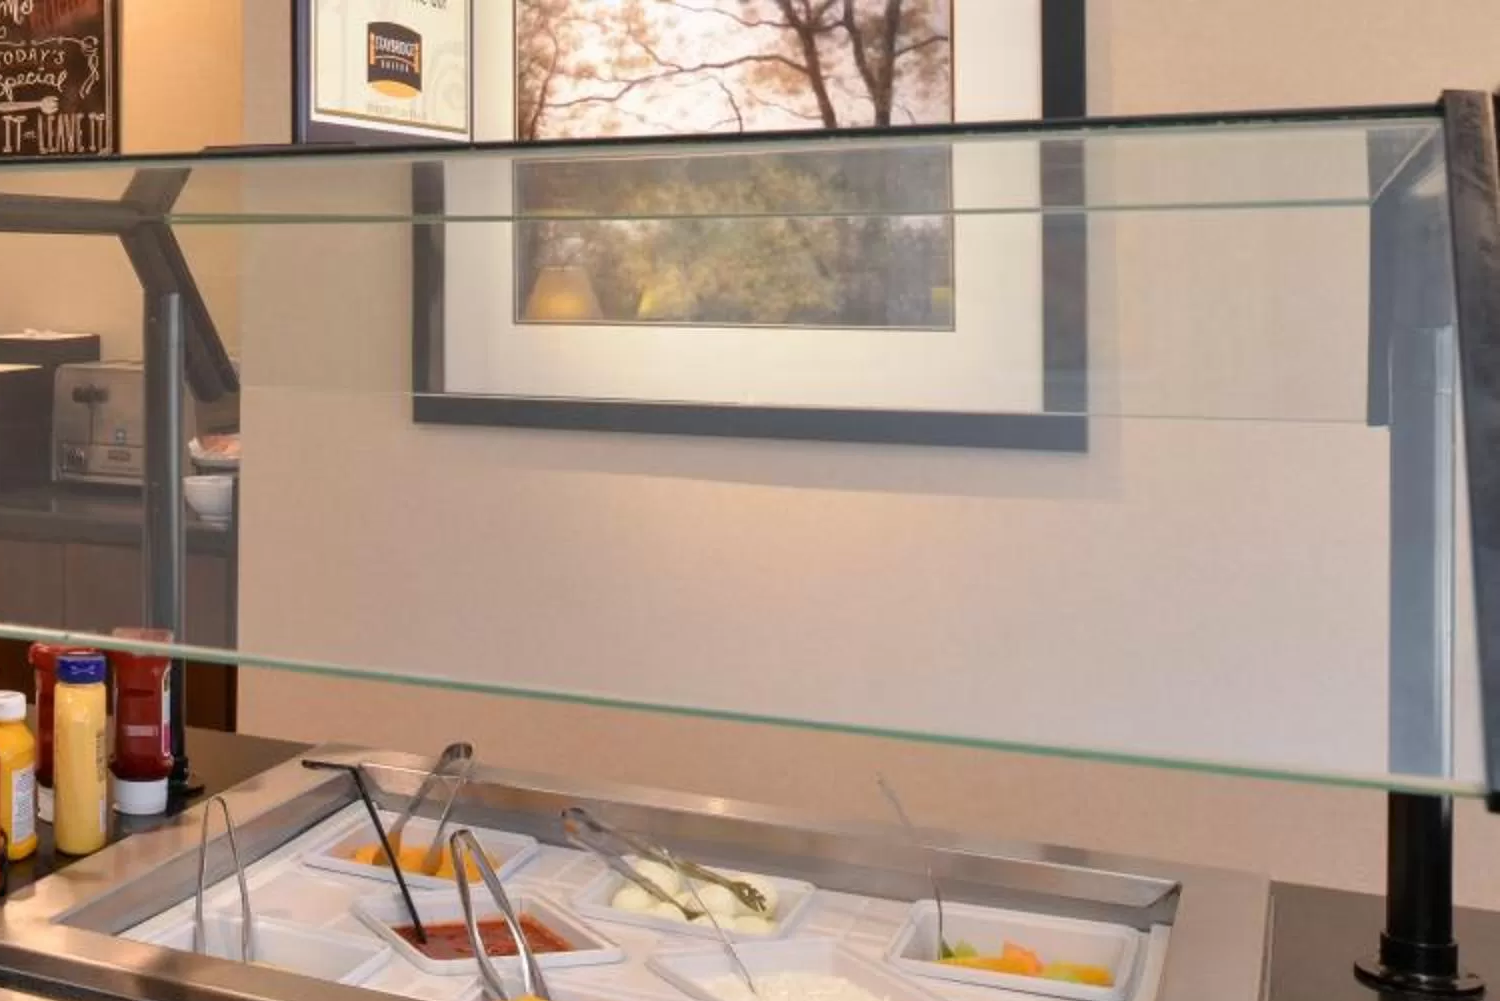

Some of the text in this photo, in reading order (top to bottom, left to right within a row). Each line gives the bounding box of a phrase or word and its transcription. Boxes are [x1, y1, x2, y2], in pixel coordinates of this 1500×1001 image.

[2, 115, 28, 153] IT
[37, 112, 85, 154] LEAVE
[88, 112, 107, 151] IT
